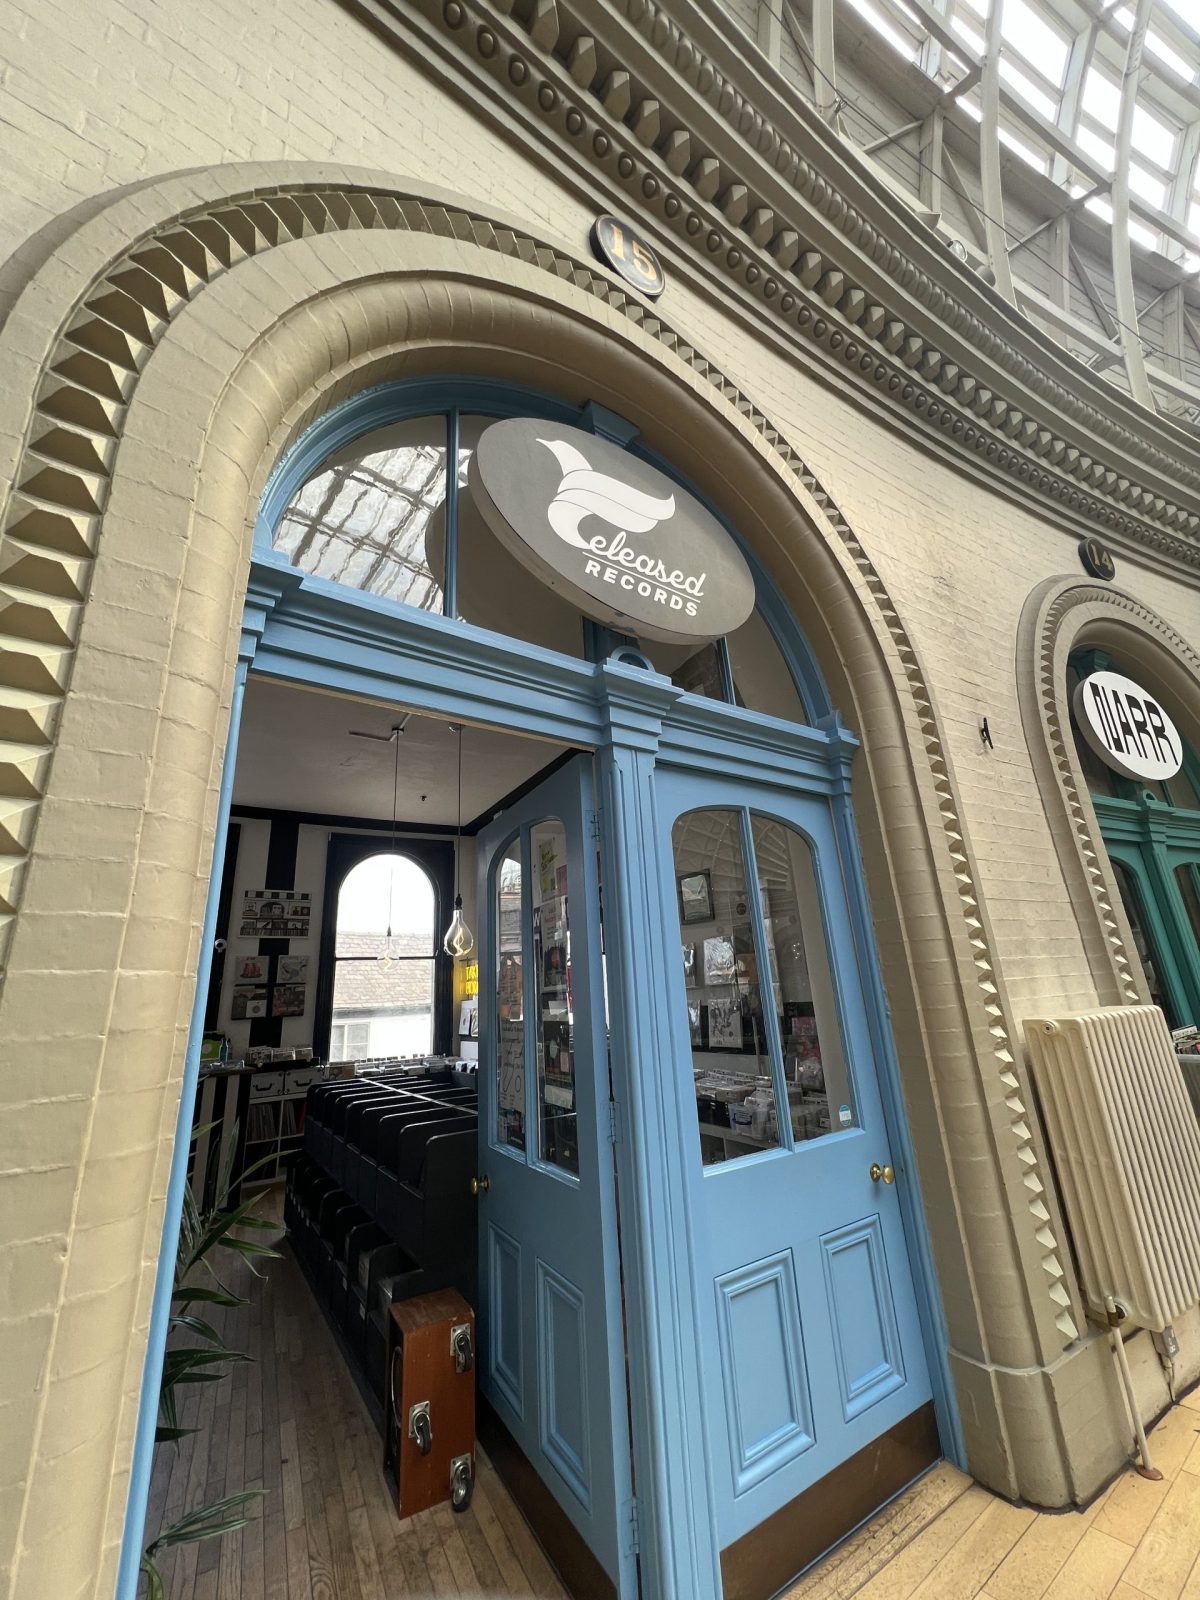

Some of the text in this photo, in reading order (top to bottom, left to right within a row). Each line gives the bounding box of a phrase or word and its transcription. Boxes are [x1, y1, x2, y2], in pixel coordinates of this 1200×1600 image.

[610, 223, 657, 281] 15
[1090, 543, 1114, 572] 14
[584, 559, 698, 617] RECORDS
